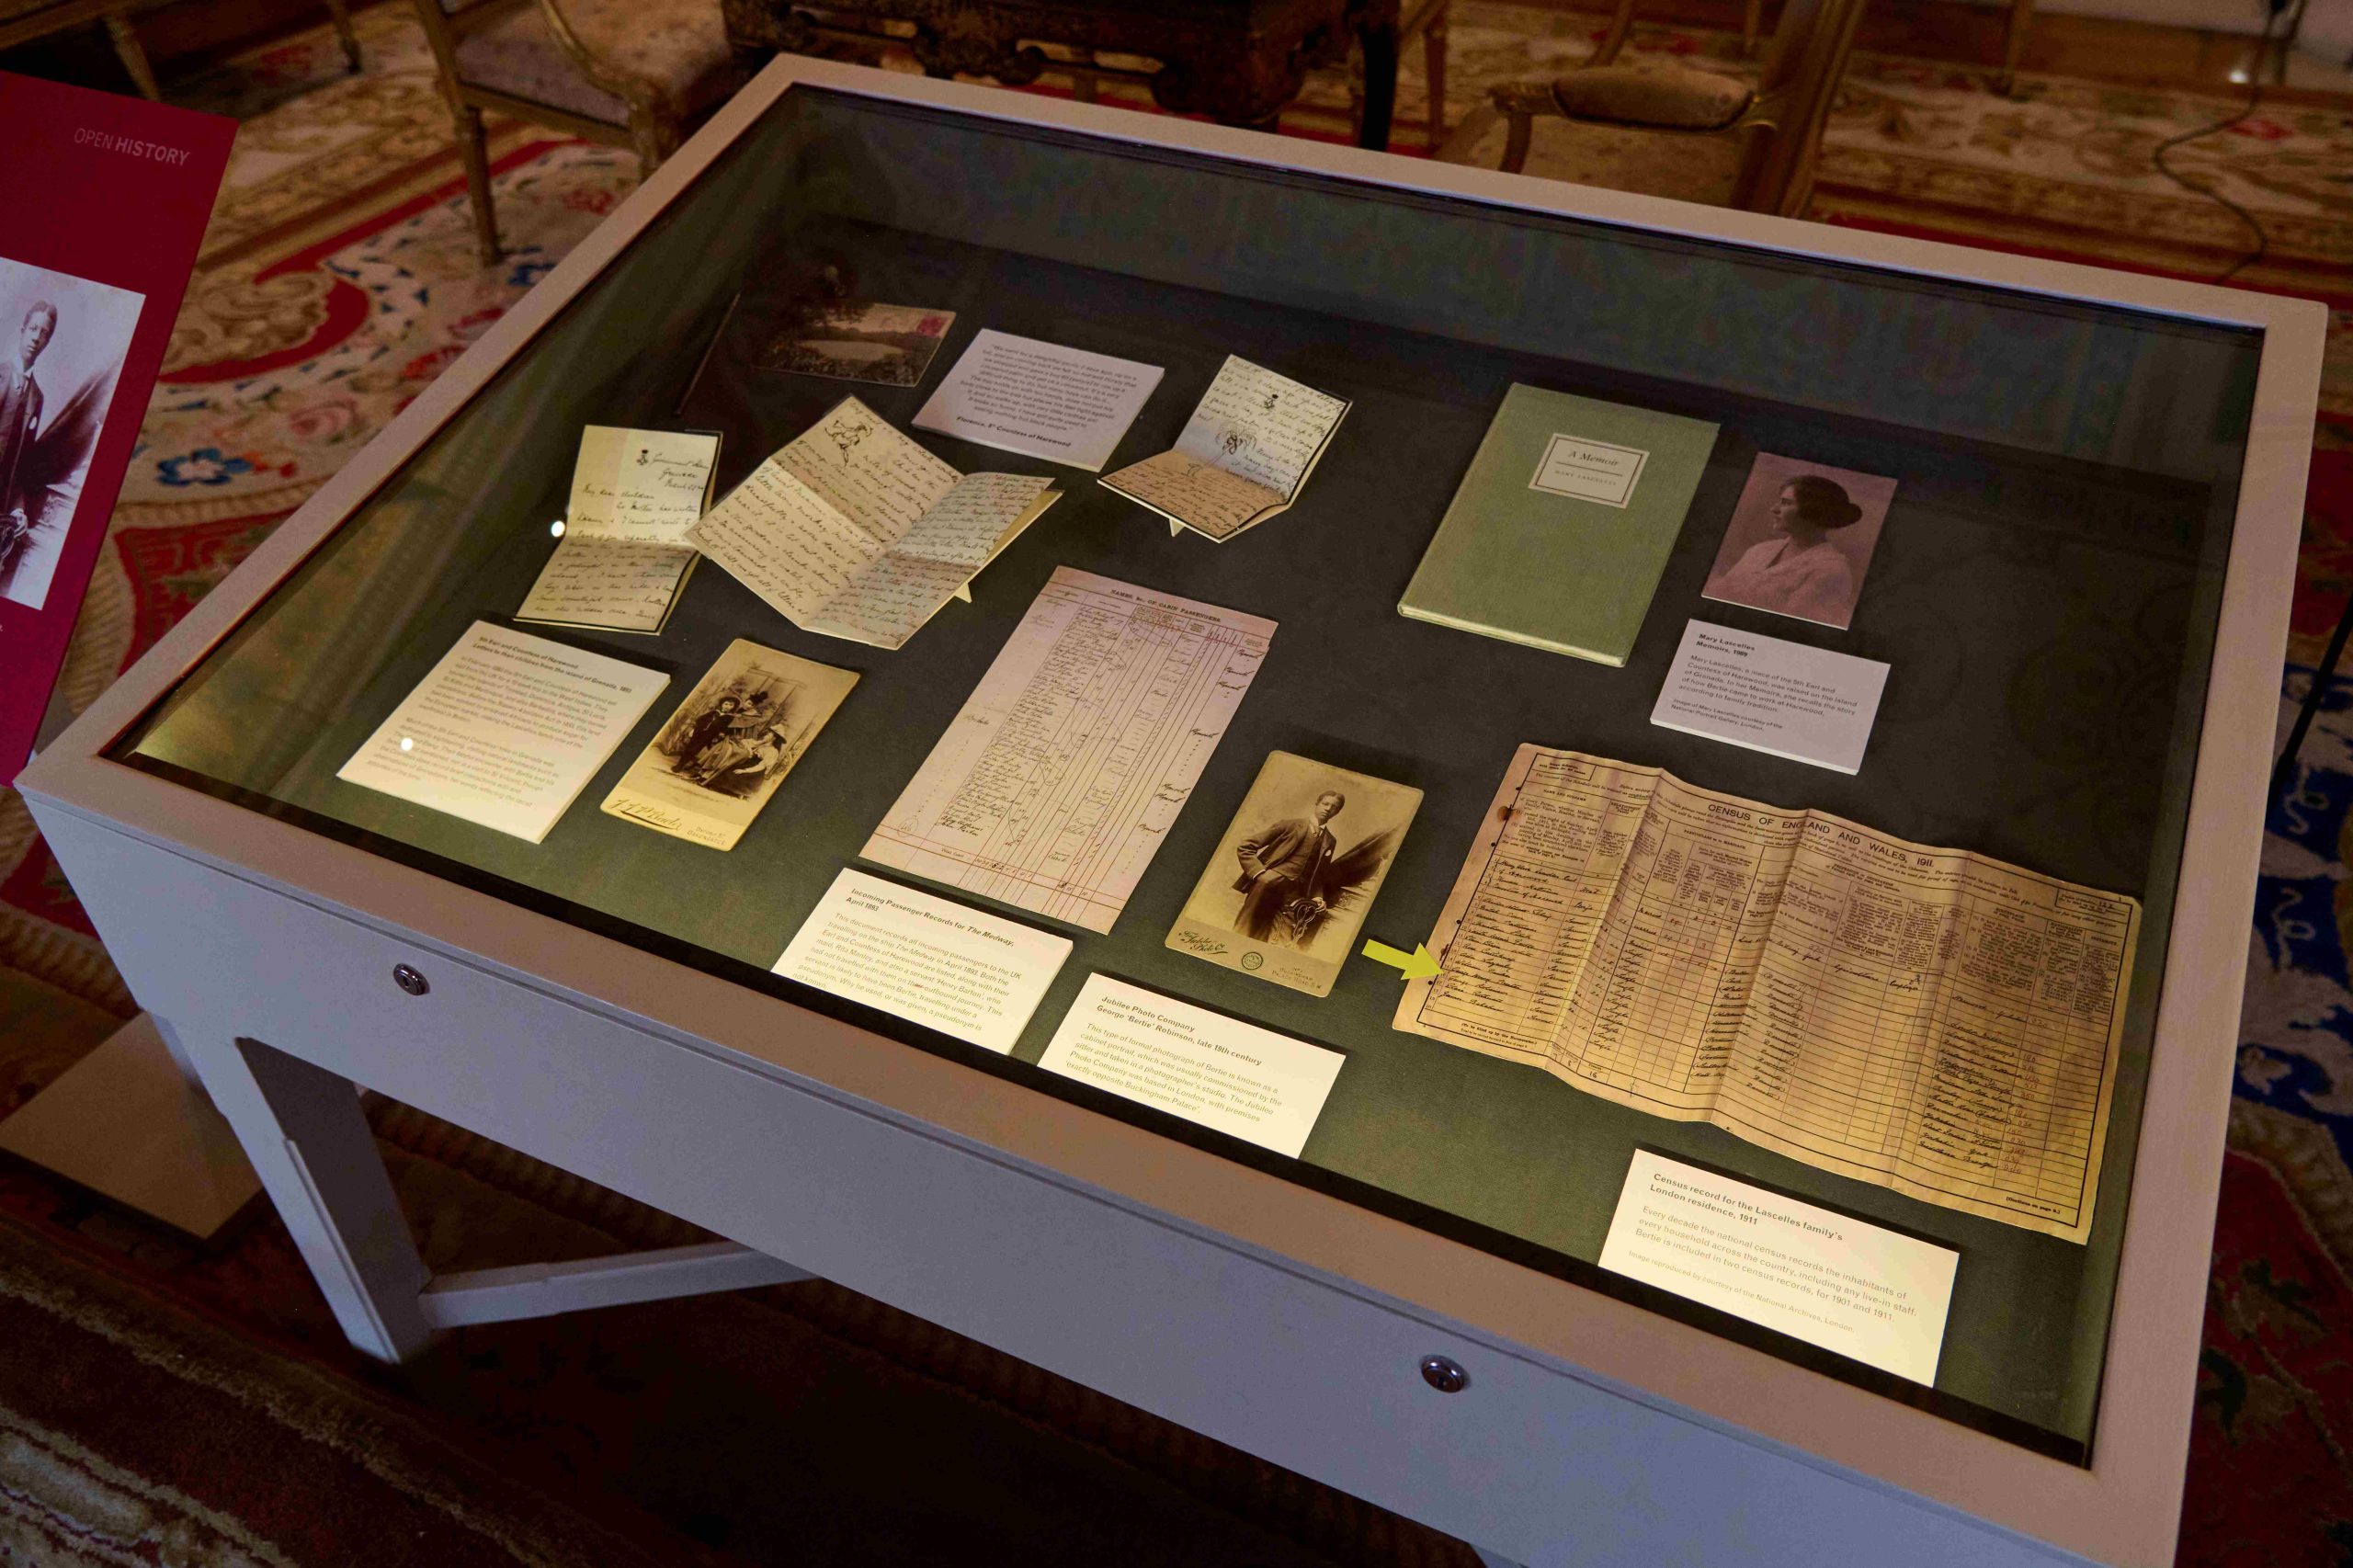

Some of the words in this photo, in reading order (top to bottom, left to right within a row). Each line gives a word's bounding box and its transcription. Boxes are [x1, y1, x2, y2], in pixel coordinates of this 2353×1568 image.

[74, 127, 114, 149] OPEN
[115, 136, 191, 166] HISTORY
[1579, 452, 1619, 466] Memoir
[1695, 640, 1732, 654] Memoirs,
[1698, 633, 1719, 643] Mary
[1719, 638, 1756, 651] Lascelles
[1708, 803, 1751, 822] CENSUS
[1758, 816, 1775, 827] OF
[1838, 832, 1861, 846] AND
[1869, 842, 1908, 862] WALES,
[845, 896, 865, 907] April
[864, 903, 881, 912] 1893
[850, 888, 886, 904] Incoming
[884, 899, 924, 916] Passenger
[923, 912, 954, 926] Records
[953, 921, 965, 929] for
[966, 926, 982, 935] The
[981, 931, 1016, 948] Medway,
[835, 912, 849, 923] This
[849, 918, 884, 934] document
[881, 929, 909, 942] records
[916, 940, 950, 957] incoming
[949, 952, 989, 969] passengers
[996, 967, 1009, 976] the
[1009, 971, 1022, 980] UK
[1096, 1005, 1125, 1019] George
[1127, 1015, 1156, 1028] 'Bertie'
[1154, 1024, 1197, 1045] Robinson,
[1196, 1039, 1213, 1049] late
[1213, 1044, 1231, 1055] 19th
[1230, 1051, 1263, 1066] century
[1101, 996, 1131, 1010] Jubilee
[1131, 1006, 1156, 1018] Photo
[1156, 1014, 1196, 1033] Company
[1074, 1042, 1095, 1053] sitter
[1093, 1049, 1110, 1058] and
[1108, 1053, 1131, 1065] taken
[1129, 1060, 1138, 1068] in
[1142, 1066, 1201, 1090] photographer's
[1200, 1086, 1228, 1099] studio.
[1230, 1094, 1245, 1105] The
[1245, 1100, 1275, 1115] Jubilee
[1079, 1033, 1108, 1047] cabinet
[1106, 1042, 1137, 1059] portrait,
[1136, 1052, 1160, 1064] which
[1160, 1061, 1176, 1070] was
[1175, 1066, 1203, 1080] usually
[1202, 1075, 1259, 1098] commissioned
[1257, 1093, 1268, 1103] by
[1268, 1096, 1282, 1107] the
[1086, 1022, 1103, 1034] This
[1102, 1028, 1120, 1040] type
[1128, 1037, 1154, 1051] formal
[1151, 1047, 1196, 1065] photograph
[1204, 1063, 1228, 1077] Bertie
[1235, 1074, 1262, 1088] known
[1065, 1059, 1093, 1075] 'exactly
[1091, 1071, 1125, 1086] opposite
[1123, 1080, 1171, 1103] Buckingham
[1170, 1096, 1202, 1114] Palace'.
[1069, 1050, 1093, 1063] Photo
[1092, 1058, 1129, 1077] Company
[1128, 1072, 1143, 1081] was
[1142, 1075, 1168, 1089] based
[1175, 1087, 1207, 1104] London,
[1208, 1099, 1226, 1110] with
[1224, 1106, 1261, 1122] premises
[1649, 1184, 1687, 1201] London
[1687, 1198, 1737, 1221] residence,
[1739, 1213, 1758, 1225] 1911
[1653, 1173, 1688, 1190] Census
[1689, 1186, 1722, 1200] record
[1722, 1195, 1736, 1205] for
[1737, 1200, 1754, 1211] the
[1755, 1206, 1802, 1227] Lascelles
[1802, 1221, 1844, 1241] family's
[1634, 1227, 1663, 1243] Bertie
[1662, 1237, 1671, 1246] is
[1672, 1243, 1712, 1260] included
[1712, 1254, 1722, 1263] in
[1722, 1257, 1740, 1268] two
[1741, 1266, 1775, 1281] census
[1776, 1278, 1815, 1296] records,
[1815, 1289, 1830, 1300] for
[1832, 1294, 1851, 1307] 1901
[1852, 1302, 1871, 1313] and
[1873, 1309, 1895, 1322] 1911.
[1638, 1219, 1663, 1232] every
[1663, 1224, 1711, 1247] household
[1711, 1243, 1743, 1258] across
[1743, 1252, 1758, 1263] the
[1758, 1258, 1799, 1278] country,
[1798, 1272, 1843, 1293] including
[1843, 1287, 1860, 1299] any
[1861, 1290, 1892, 1308] live-in
[1893, 1303, 1918, 1317] staff.
[1642, 1205, 1667, 1221] Every
[1666, 1214, 1700, 1231] decade
[1699, 1225, 1715, 1235] the
[1716, 1232, 1754, 1249] national
[1754, 1244, 1787, 1260] census
[1788, 1256, 1824, 1273] records
[1825, 1267, 1840, 1278] the
[1841, 1272, 1895, 1296] inhabitants
[1895, 1291, 1907, 1300] of
